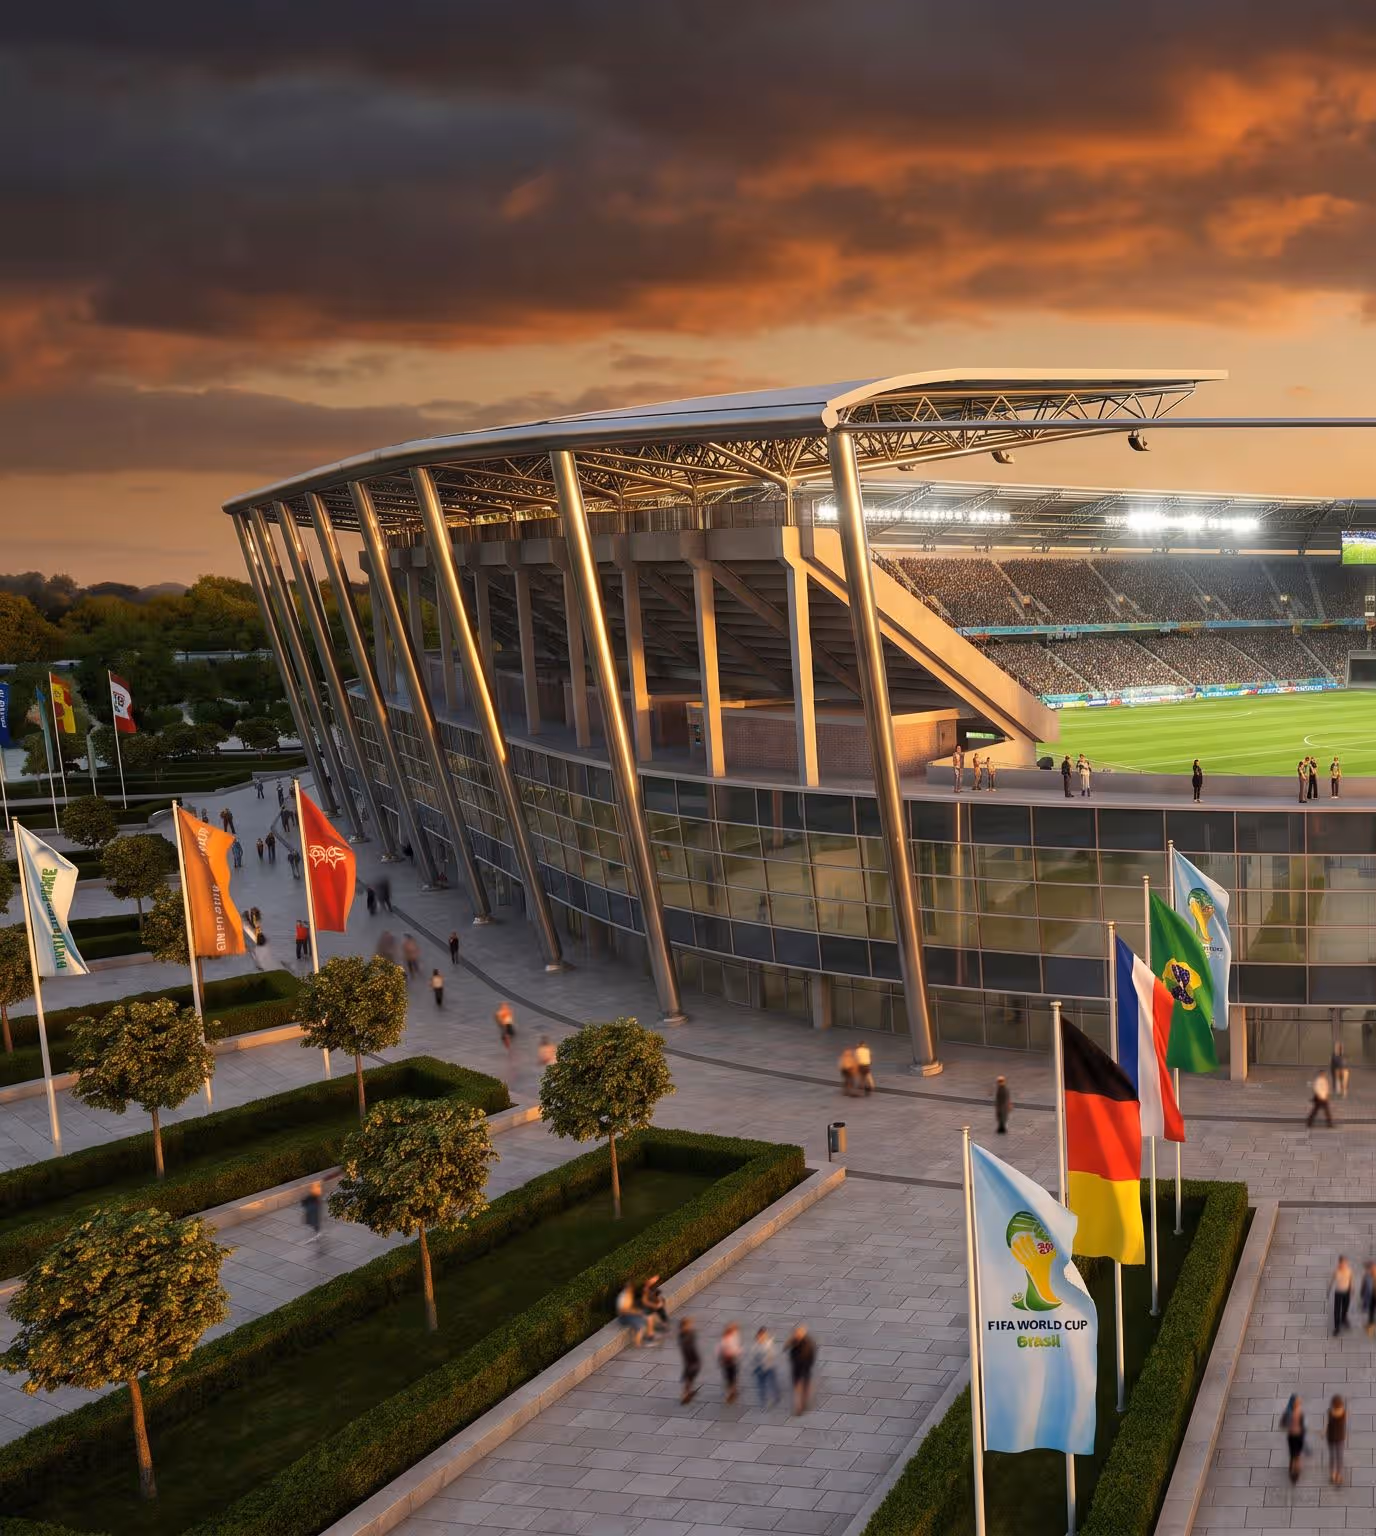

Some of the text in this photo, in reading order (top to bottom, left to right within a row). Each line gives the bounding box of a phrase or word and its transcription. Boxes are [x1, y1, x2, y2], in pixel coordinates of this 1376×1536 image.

[987, 1319, 1088, 1331] FIFA WORLD CUP
